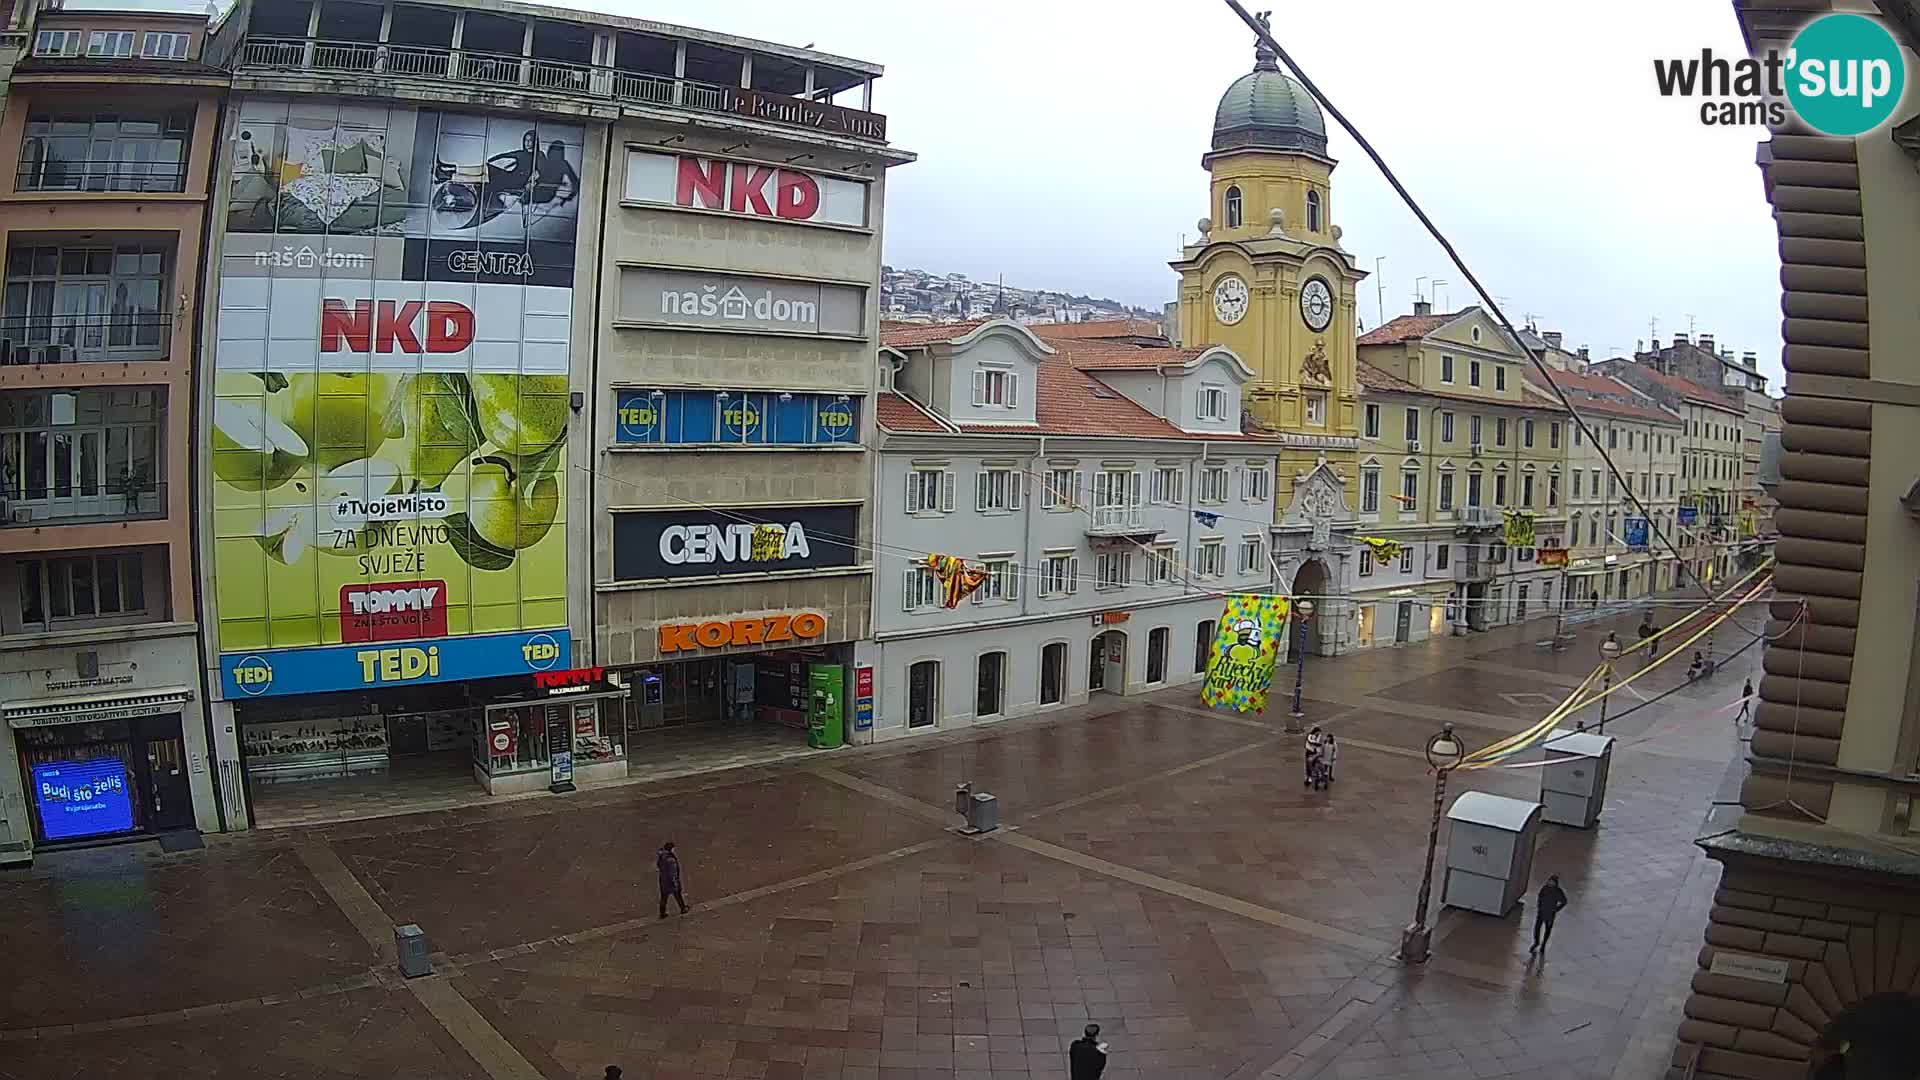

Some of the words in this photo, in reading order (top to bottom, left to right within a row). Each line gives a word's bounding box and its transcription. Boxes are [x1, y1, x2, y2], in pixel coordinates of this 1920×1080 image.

[722, 88, 745, 113] Le
[676, 158, 820, 220] NKD
[254, 247, 293, 268] naš
[319, 248, 365, 269] dom
[449, 250, 535, 276] CENTRA
[661, 284, 718, 316] naš
[754, 291, 816, 323] dom
[320, 298, 476, 353] NKD
[619, 408, 658, 425] TEDi
[723, 409, 760, 427] TEDi
[819, 411, 853, 427] TEDi
[338, 498, 446, 517] #TvojeMisto
[333, 529, 357, 549] ZA
[365, 524, 450, 548] DNEVNO
[359, 548, 426, 576] SVJEŽE
[348, 586, 438, 615] TOMMY
[660, 613, 826, 653] KORZO
[357, 646, 440, 683] TEDi
[522, 643, 560, 661] TEDi
[233, 667, 273, 684] TEDi
[534, 665, 605, 689] TOMMY
[42, 782, 71, 801] Budi
